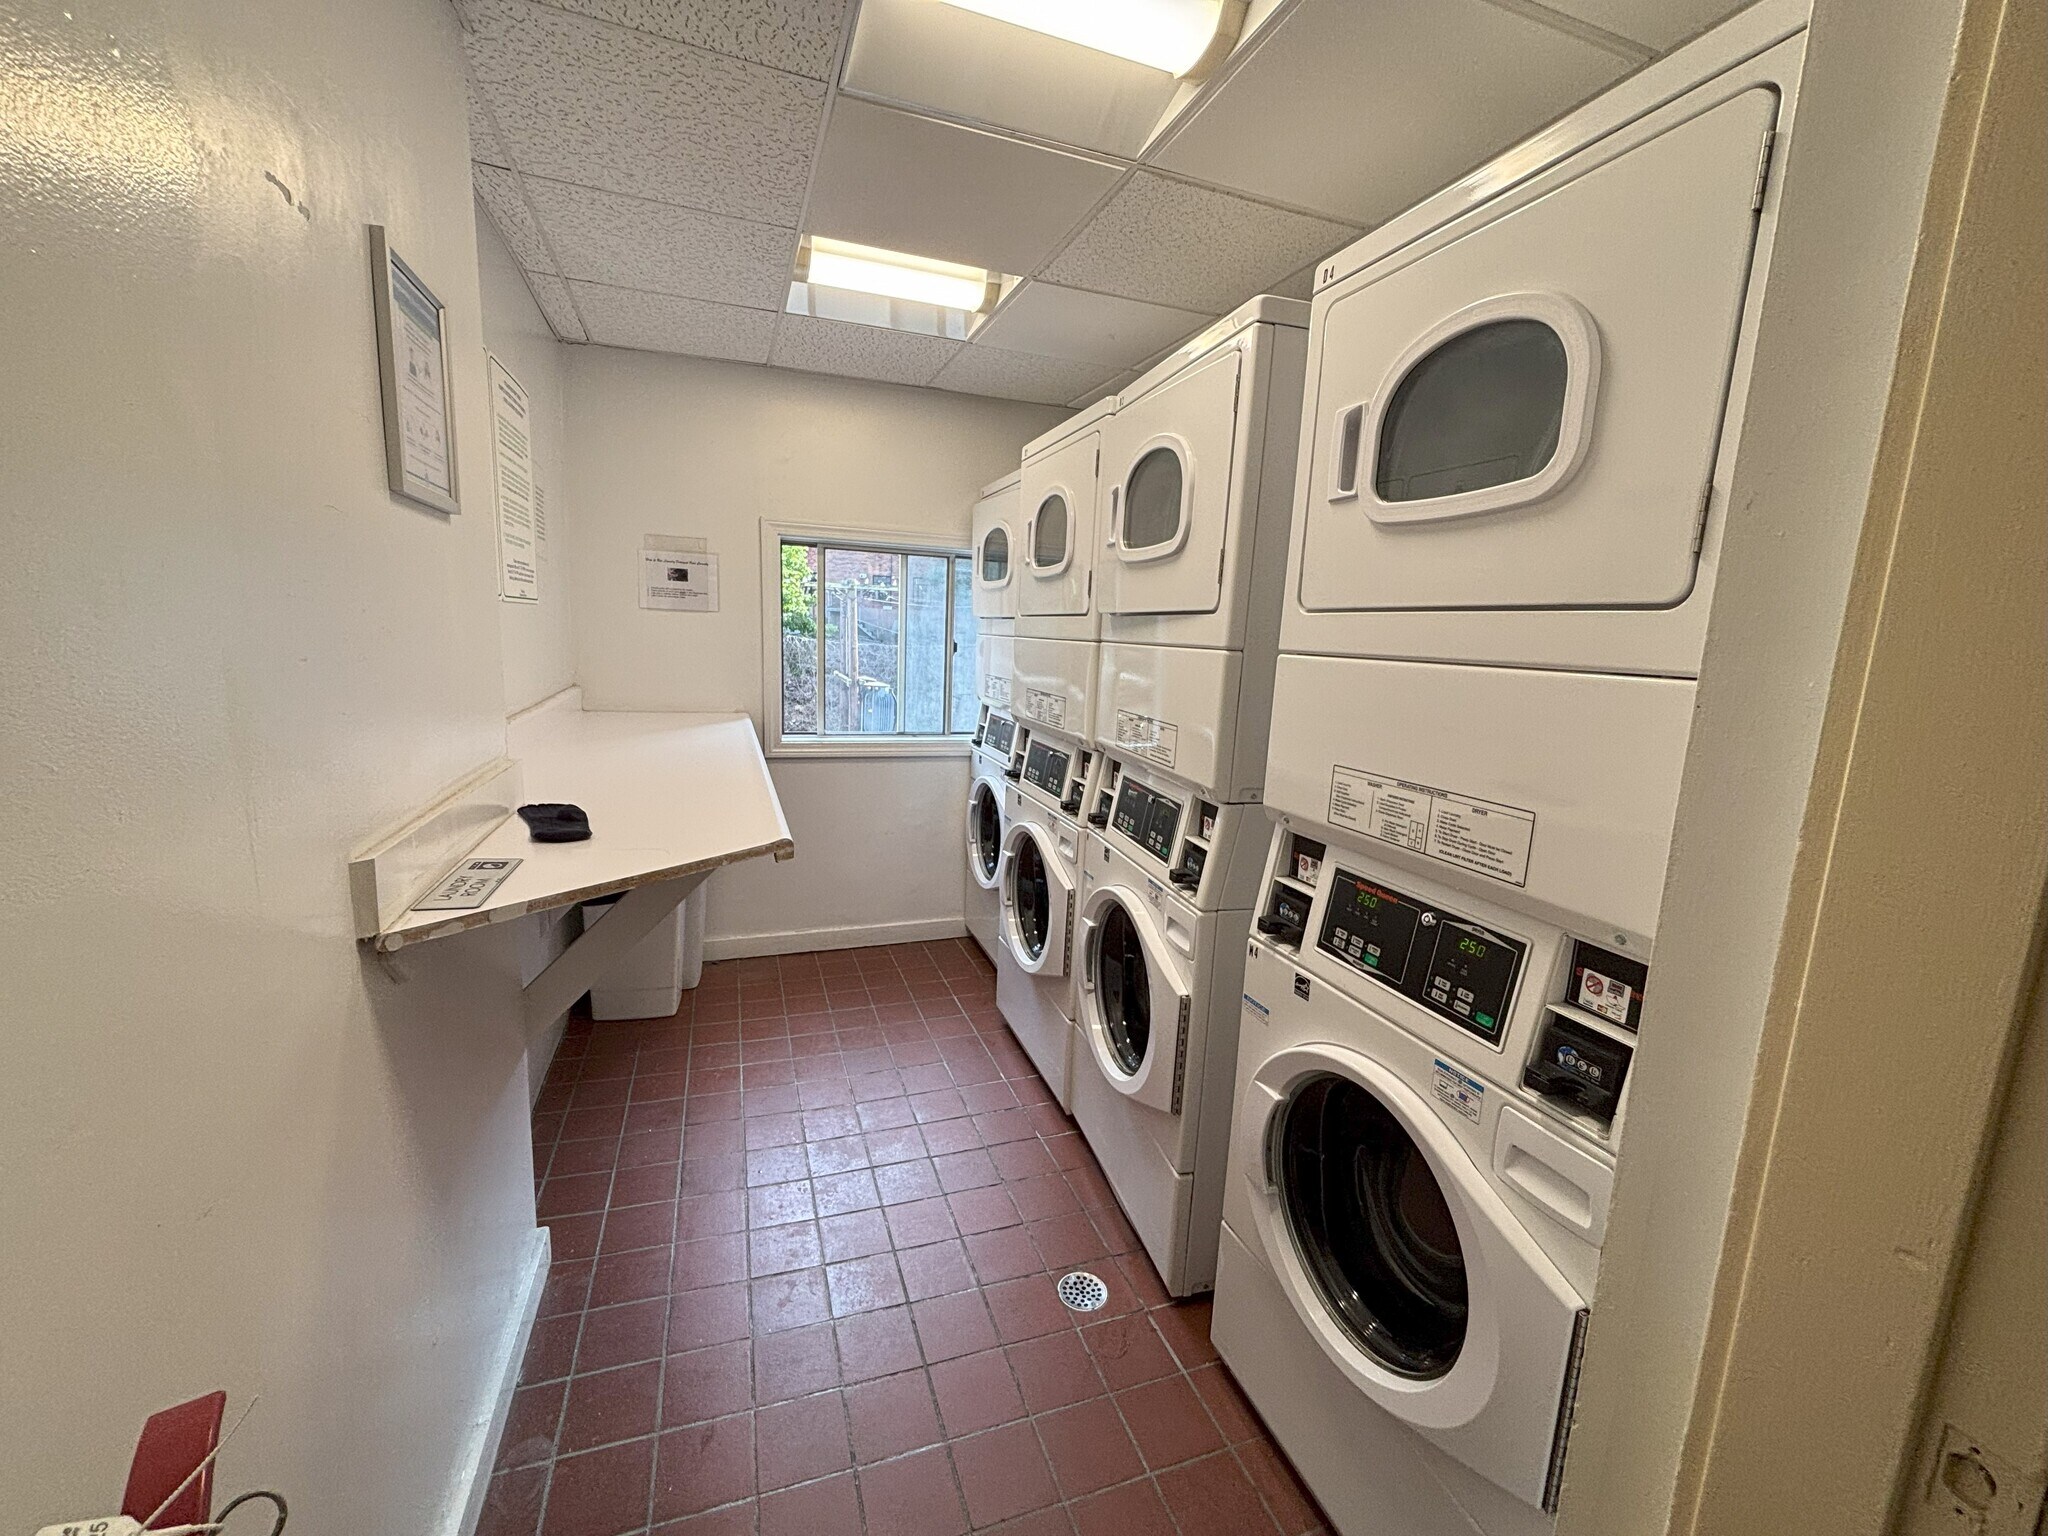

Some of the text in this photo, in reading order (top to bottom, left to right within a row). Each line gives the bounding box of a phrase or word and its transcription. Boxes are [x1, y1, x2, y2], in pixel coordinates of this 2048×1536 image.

[1472, 808, 1488, 817] DRYER
[1357, 892, 1378, 908] 250
[1460, 938, 1486, 958] 250
